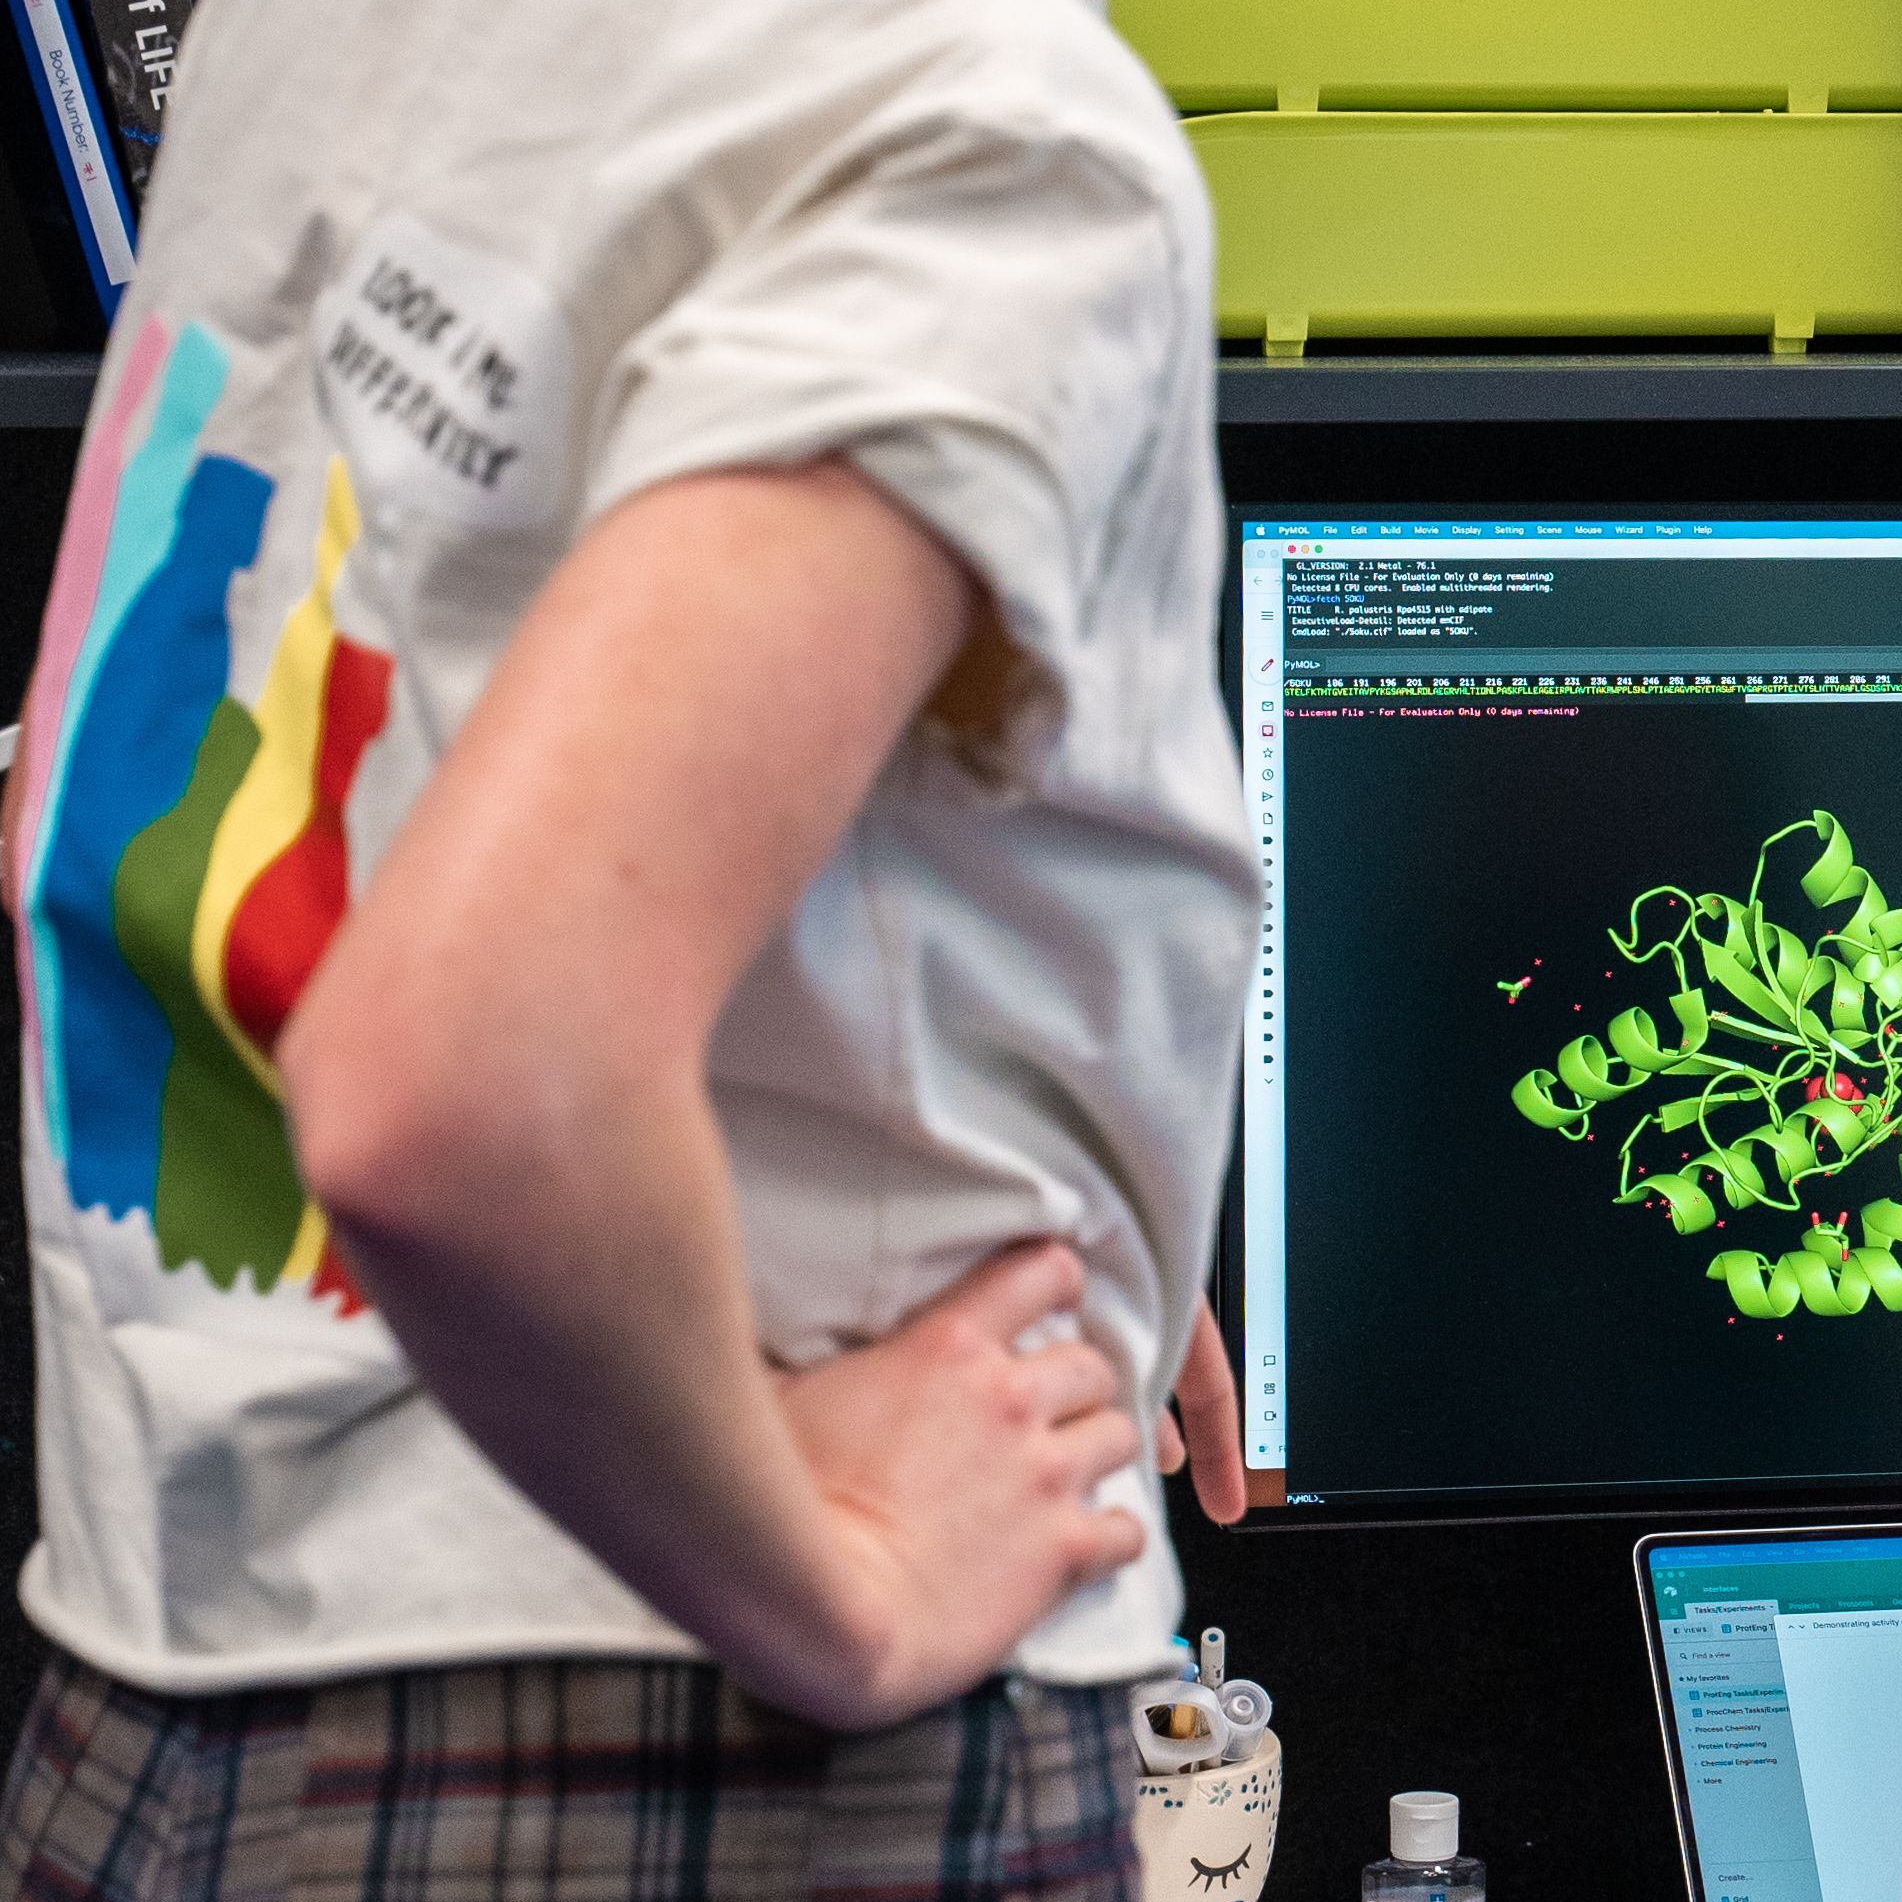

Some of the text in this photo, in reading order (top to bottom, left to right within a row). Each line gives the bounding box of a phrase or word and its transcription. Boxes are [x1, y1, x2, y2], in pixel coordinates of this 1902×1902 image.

[49, 49, 90, 153] Book Number:
[1279, 526, 1712, 536] PyMOL File Edit Build Movie Display Setting Scene Mouse Wizard Plugin Help
[1377, 562, 1401, 570] Metal
[1301, 573, 1335, 581] License
[1339, 573, 1358, 581] File
[1373, 573, 1387, 581] For
[1392, 573, 1439, 581] Evaluation
[1444, 573, 1463, 583] Only
[1482, 573, 1501, 583] days
[1506, 573, 1553, 583] remaining)
[1292, 584, 1552, 594] Detected CPU cores. Enabled multithreaded rendering.
[1287, 605, 1311, 614] TITLE
[1349, 605, 1392, 615] palustris
[1434, 605, 1453, 614] with
[1396, 616, 1434, 625] Detected
[1292, 627, 1330, 636] CmdLoad:
[1396, 627, 1425, 636] loaded
[1284, 661, 1320, 670] PyMOL>
[1694, 1604, 1765, 1614] Tasks/Experiments
[1812, 1620, 1870, 1629] Demonstrating
[1872, 1618, 1900, 1629] activity
[1736, 1624, 1768, 1633] ProtEng
[1725, 1724, 1761, 1732] Chemistry
[1725, 1741, 1767, 1749] Engineering
[1736, 1758, 1777, 1766] Engineering
